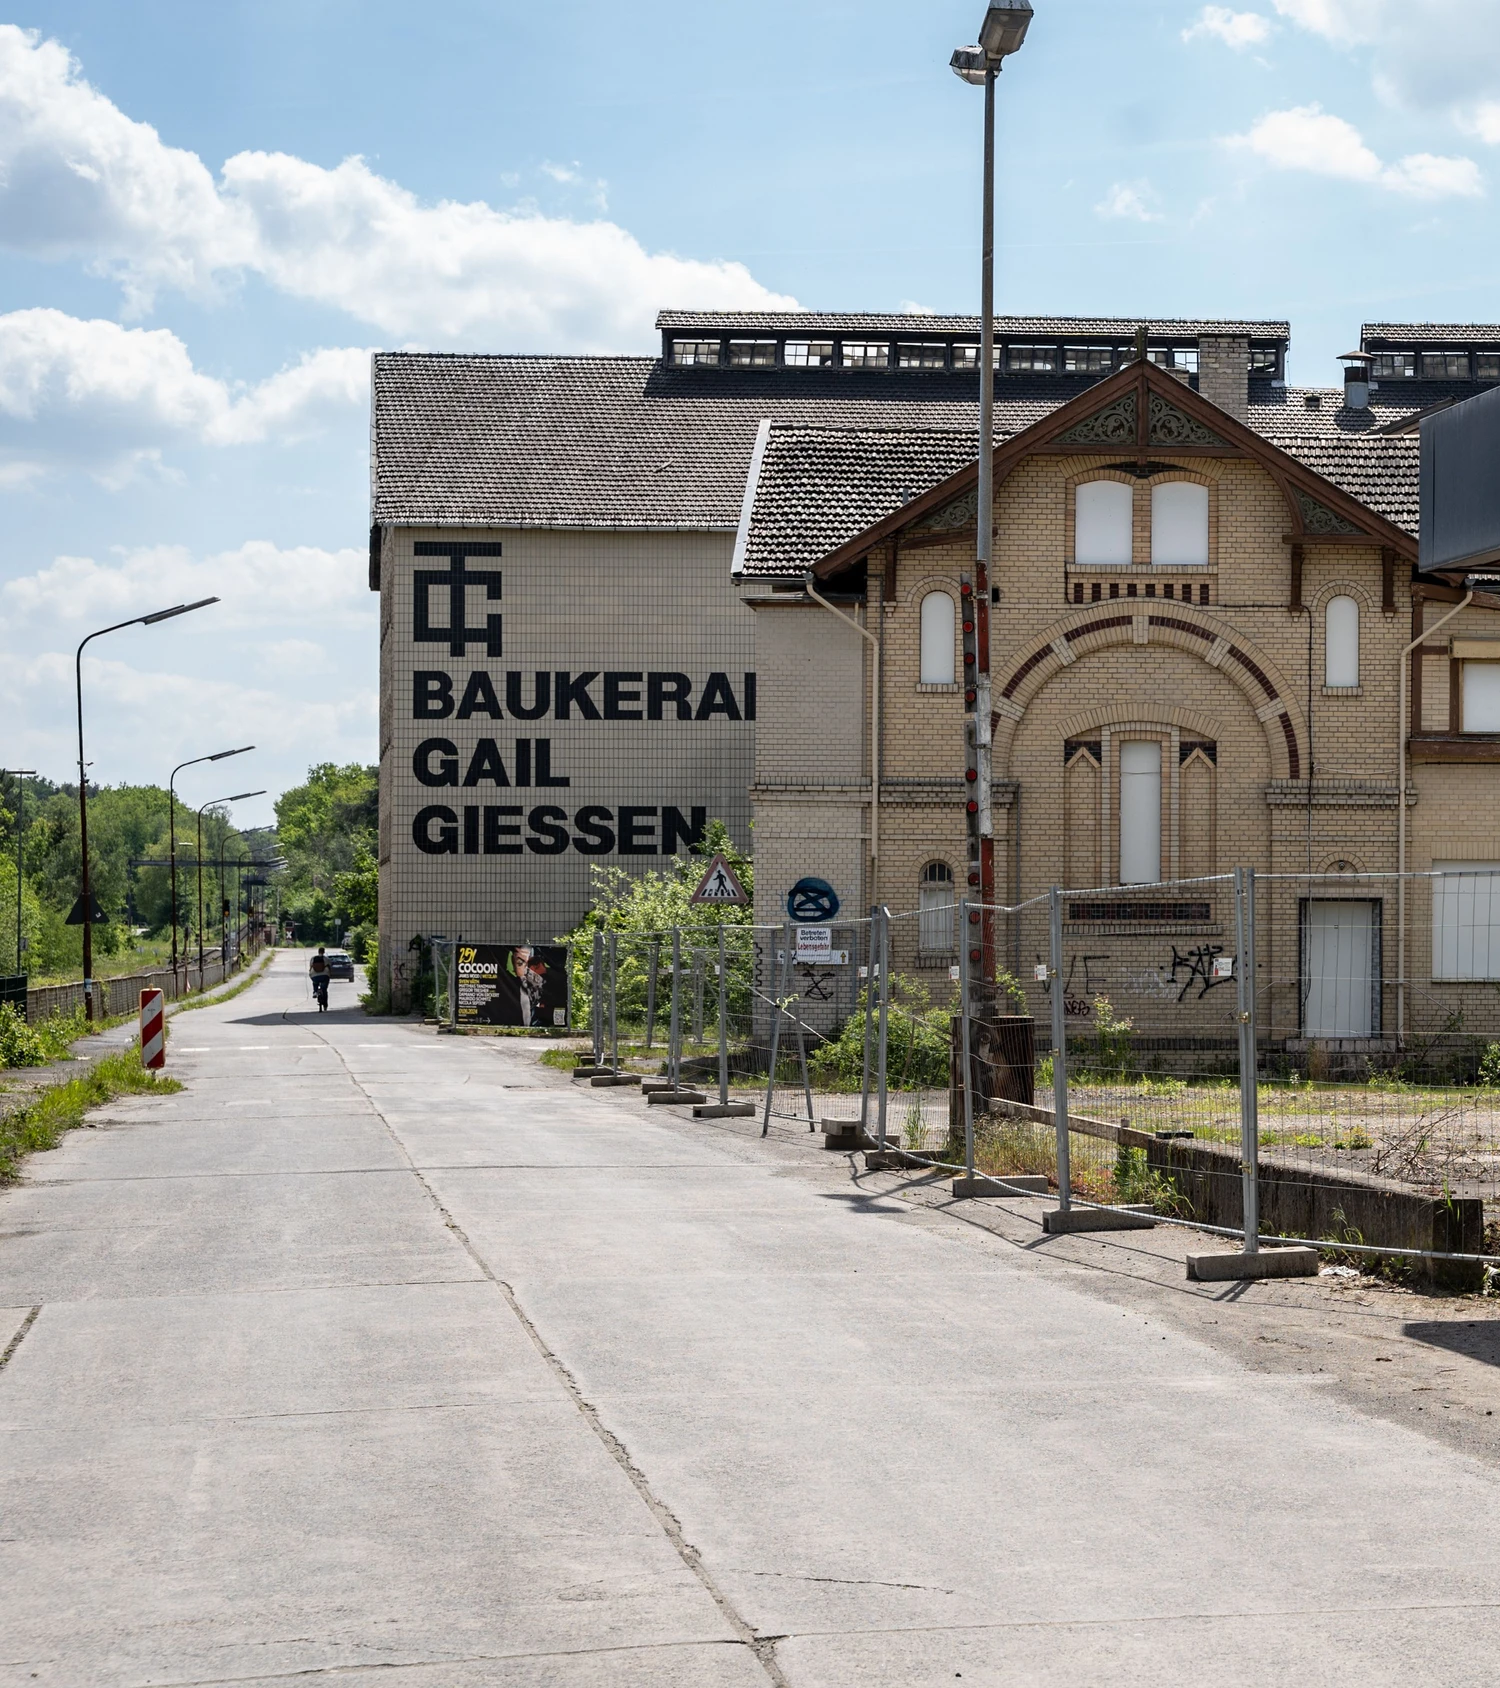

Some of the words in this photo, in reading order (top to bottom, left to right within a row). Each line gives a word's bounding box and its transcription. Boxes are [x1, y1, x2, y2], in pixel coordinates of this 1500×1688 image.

[413, 670, 756, 721] BAUKERA
[412, 737, 570, 788] GAIL
[412, 804, 706, 855] GIESSEN
[458, 963, 498, 974] COCOON
